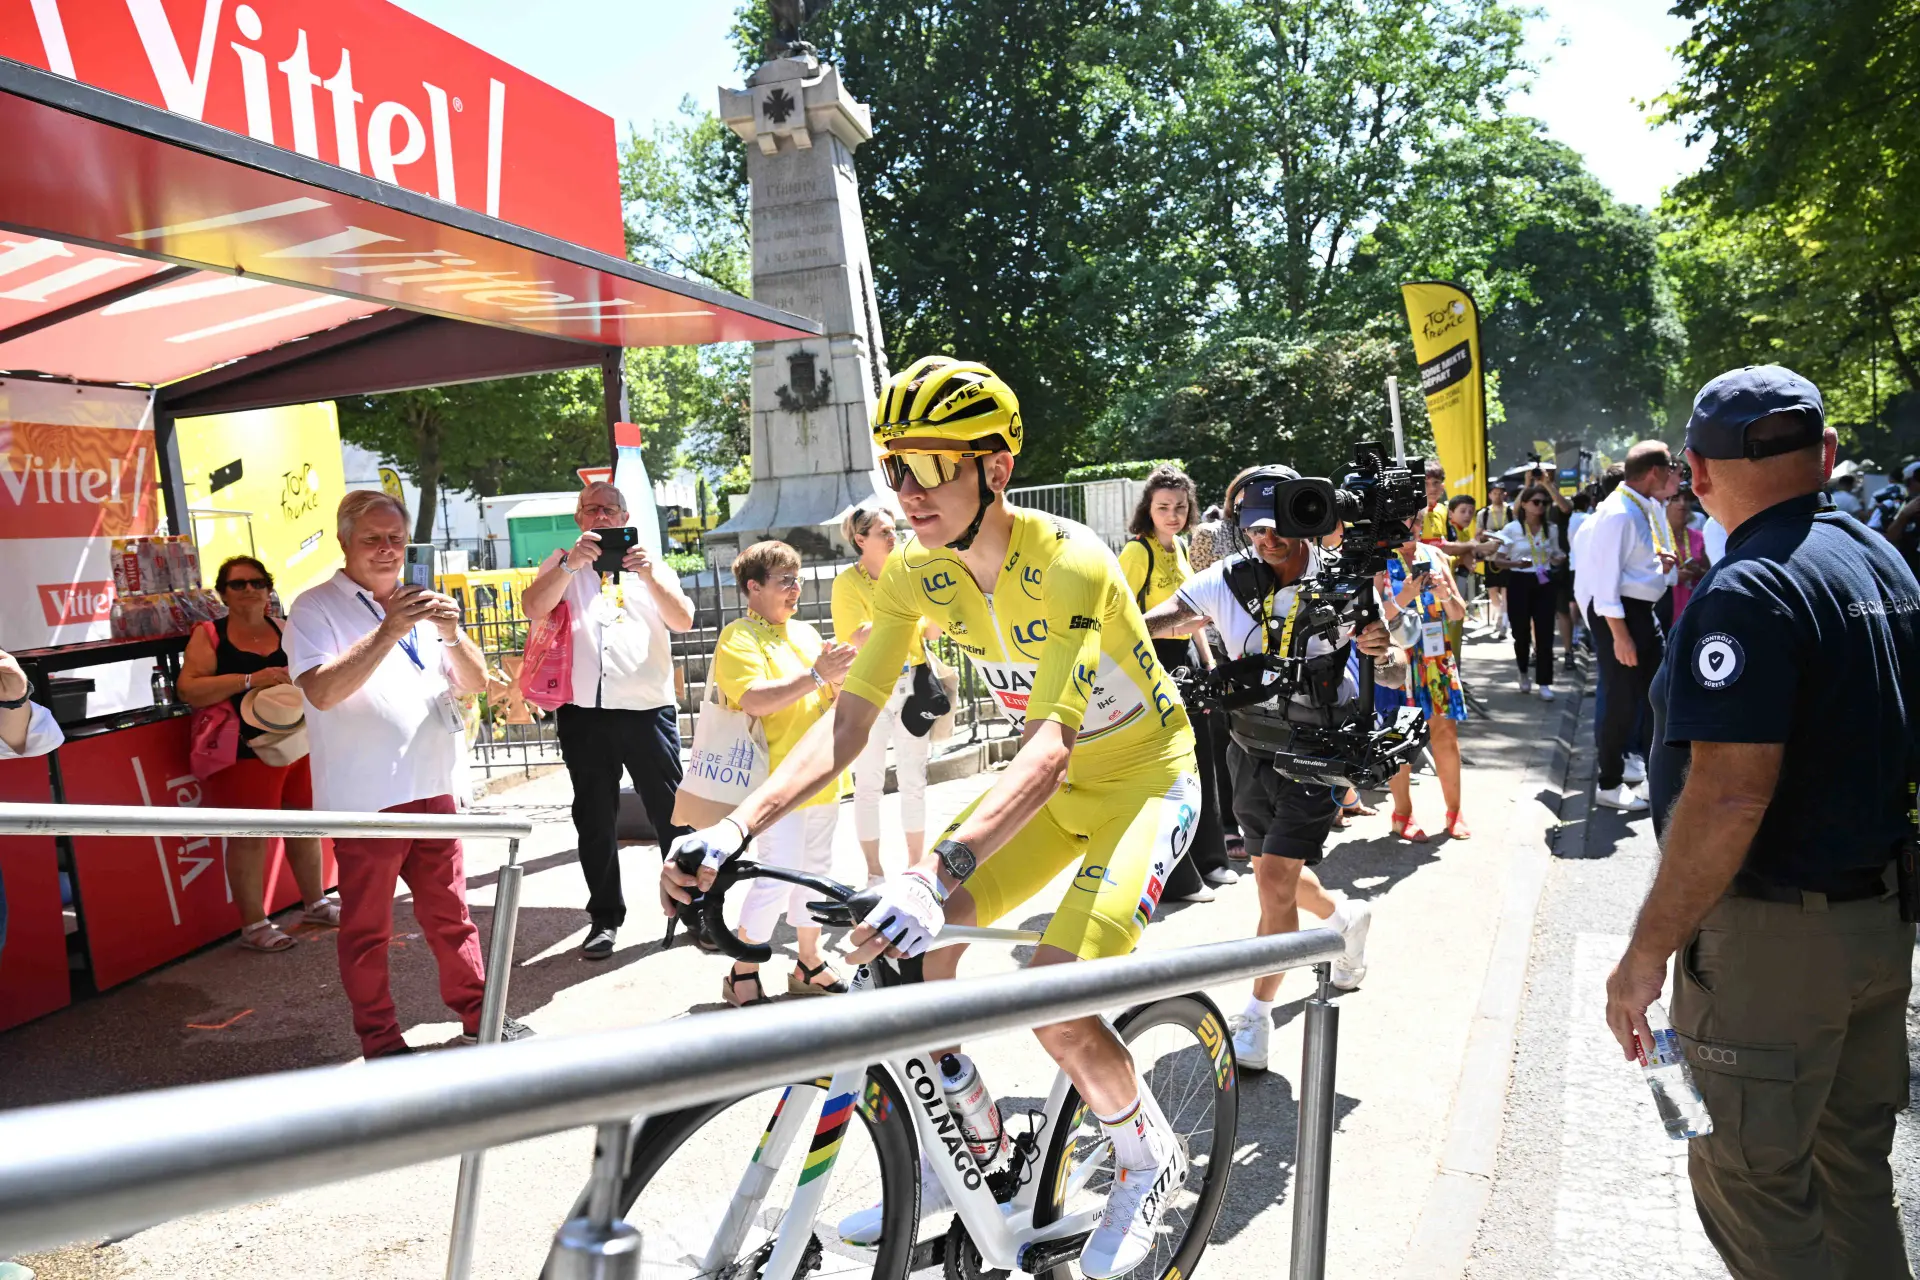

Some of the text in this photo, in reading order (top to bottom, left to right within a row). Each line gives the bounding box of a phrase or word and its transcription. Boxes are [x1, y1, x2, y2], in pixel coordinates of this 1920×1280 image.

[1441, 348, 1467, 370] MIXTE
[944, 380, 985, 410] MET
[0, 453, 124, 506] Vittel
[923, 571, 957, 593] LCL
[1024, 566, 1043, 585] LC
[48, 587, 115, 620] Vittel
[1133, 640, 1155, 680] LCL
[983, 666, 1037, 692] UA
[1078, 664, 1097, 687] LC
[1097, 695, 1117, 709] IHC
[1152, 681, 1174, 727] LCL
[706, 753, 723, 764] DE
[165, 774, 215, 891] Viel
[1076, 865, 1117, 886] LCL
[905, 1058, 982, 1191] COLNAGO
